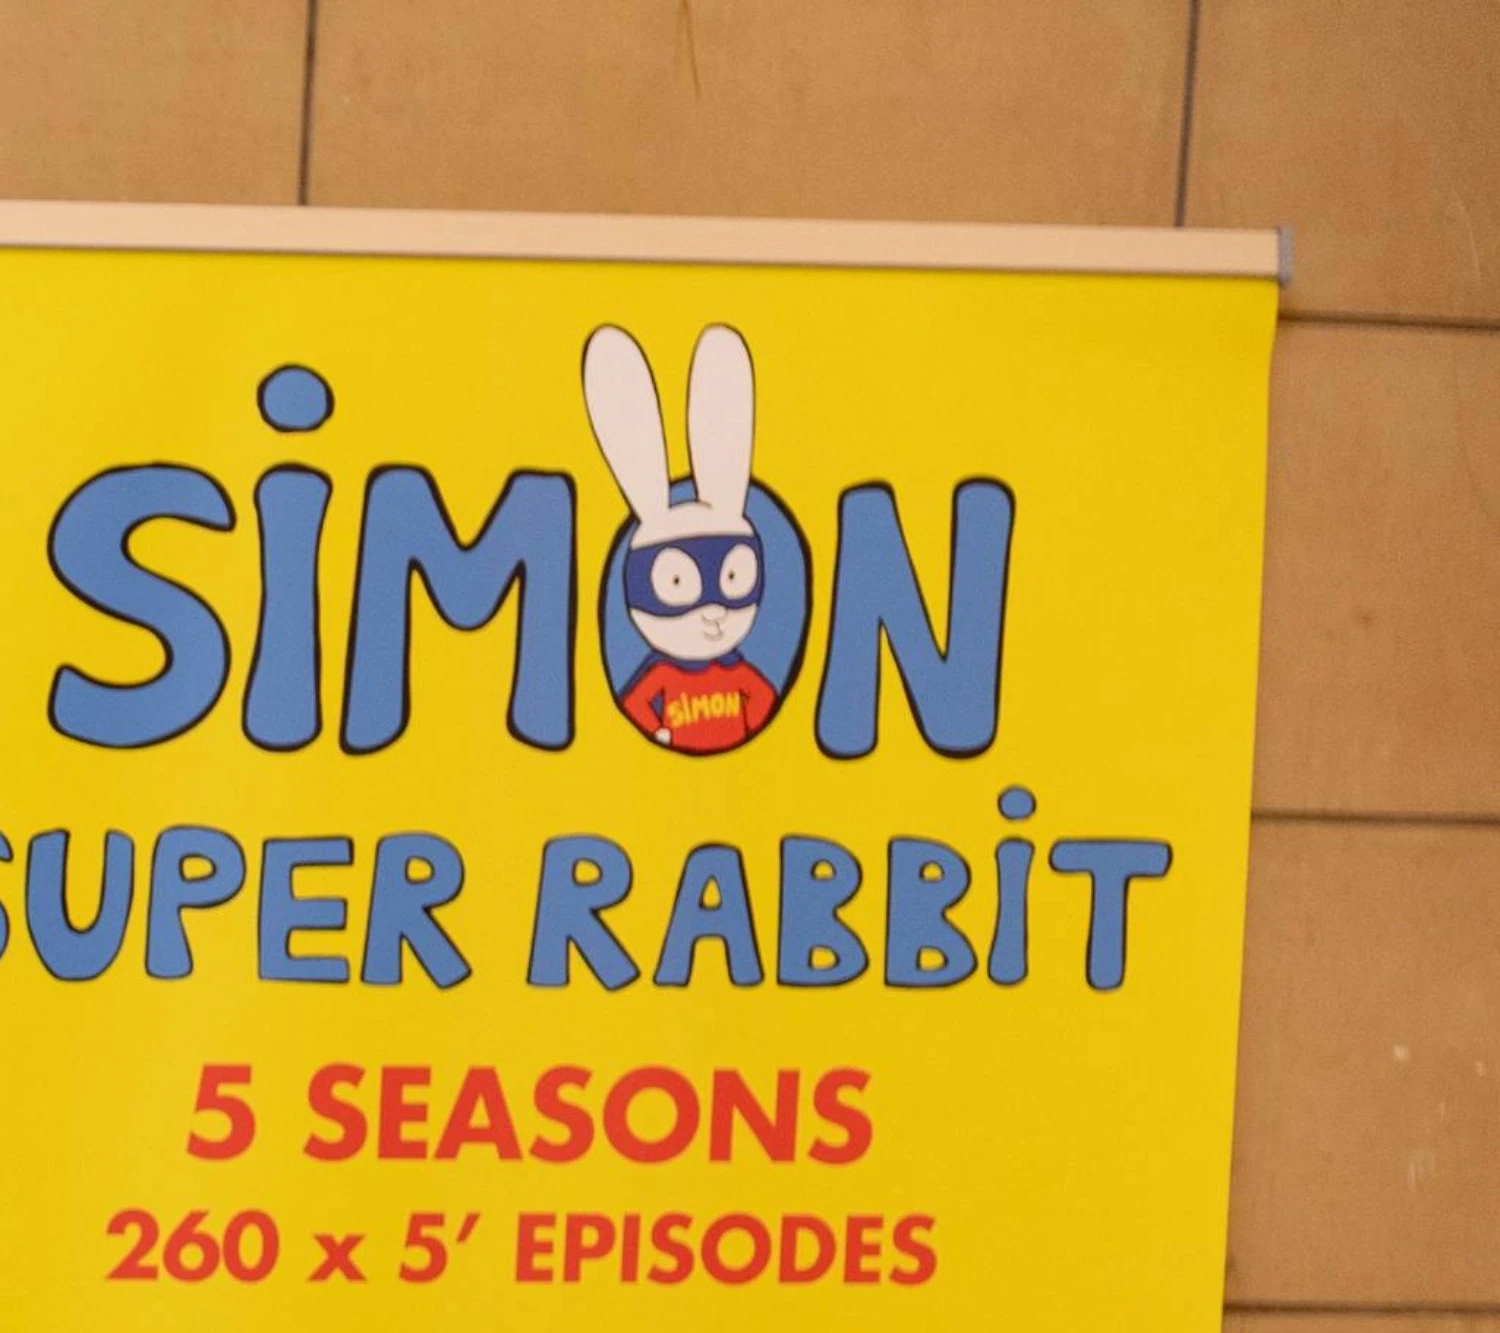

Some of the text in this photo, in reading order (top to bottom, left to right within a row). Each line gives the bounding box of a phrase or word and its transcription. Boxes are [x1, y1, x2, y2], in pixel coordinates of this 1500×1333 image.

[186, 1062, 875, 1165] 5 SEASONS
[105, 1207, 279, 1283] 260
[308, 1232, 367, 1283] x
[515, 1210, 938, 1286] EPISODES
